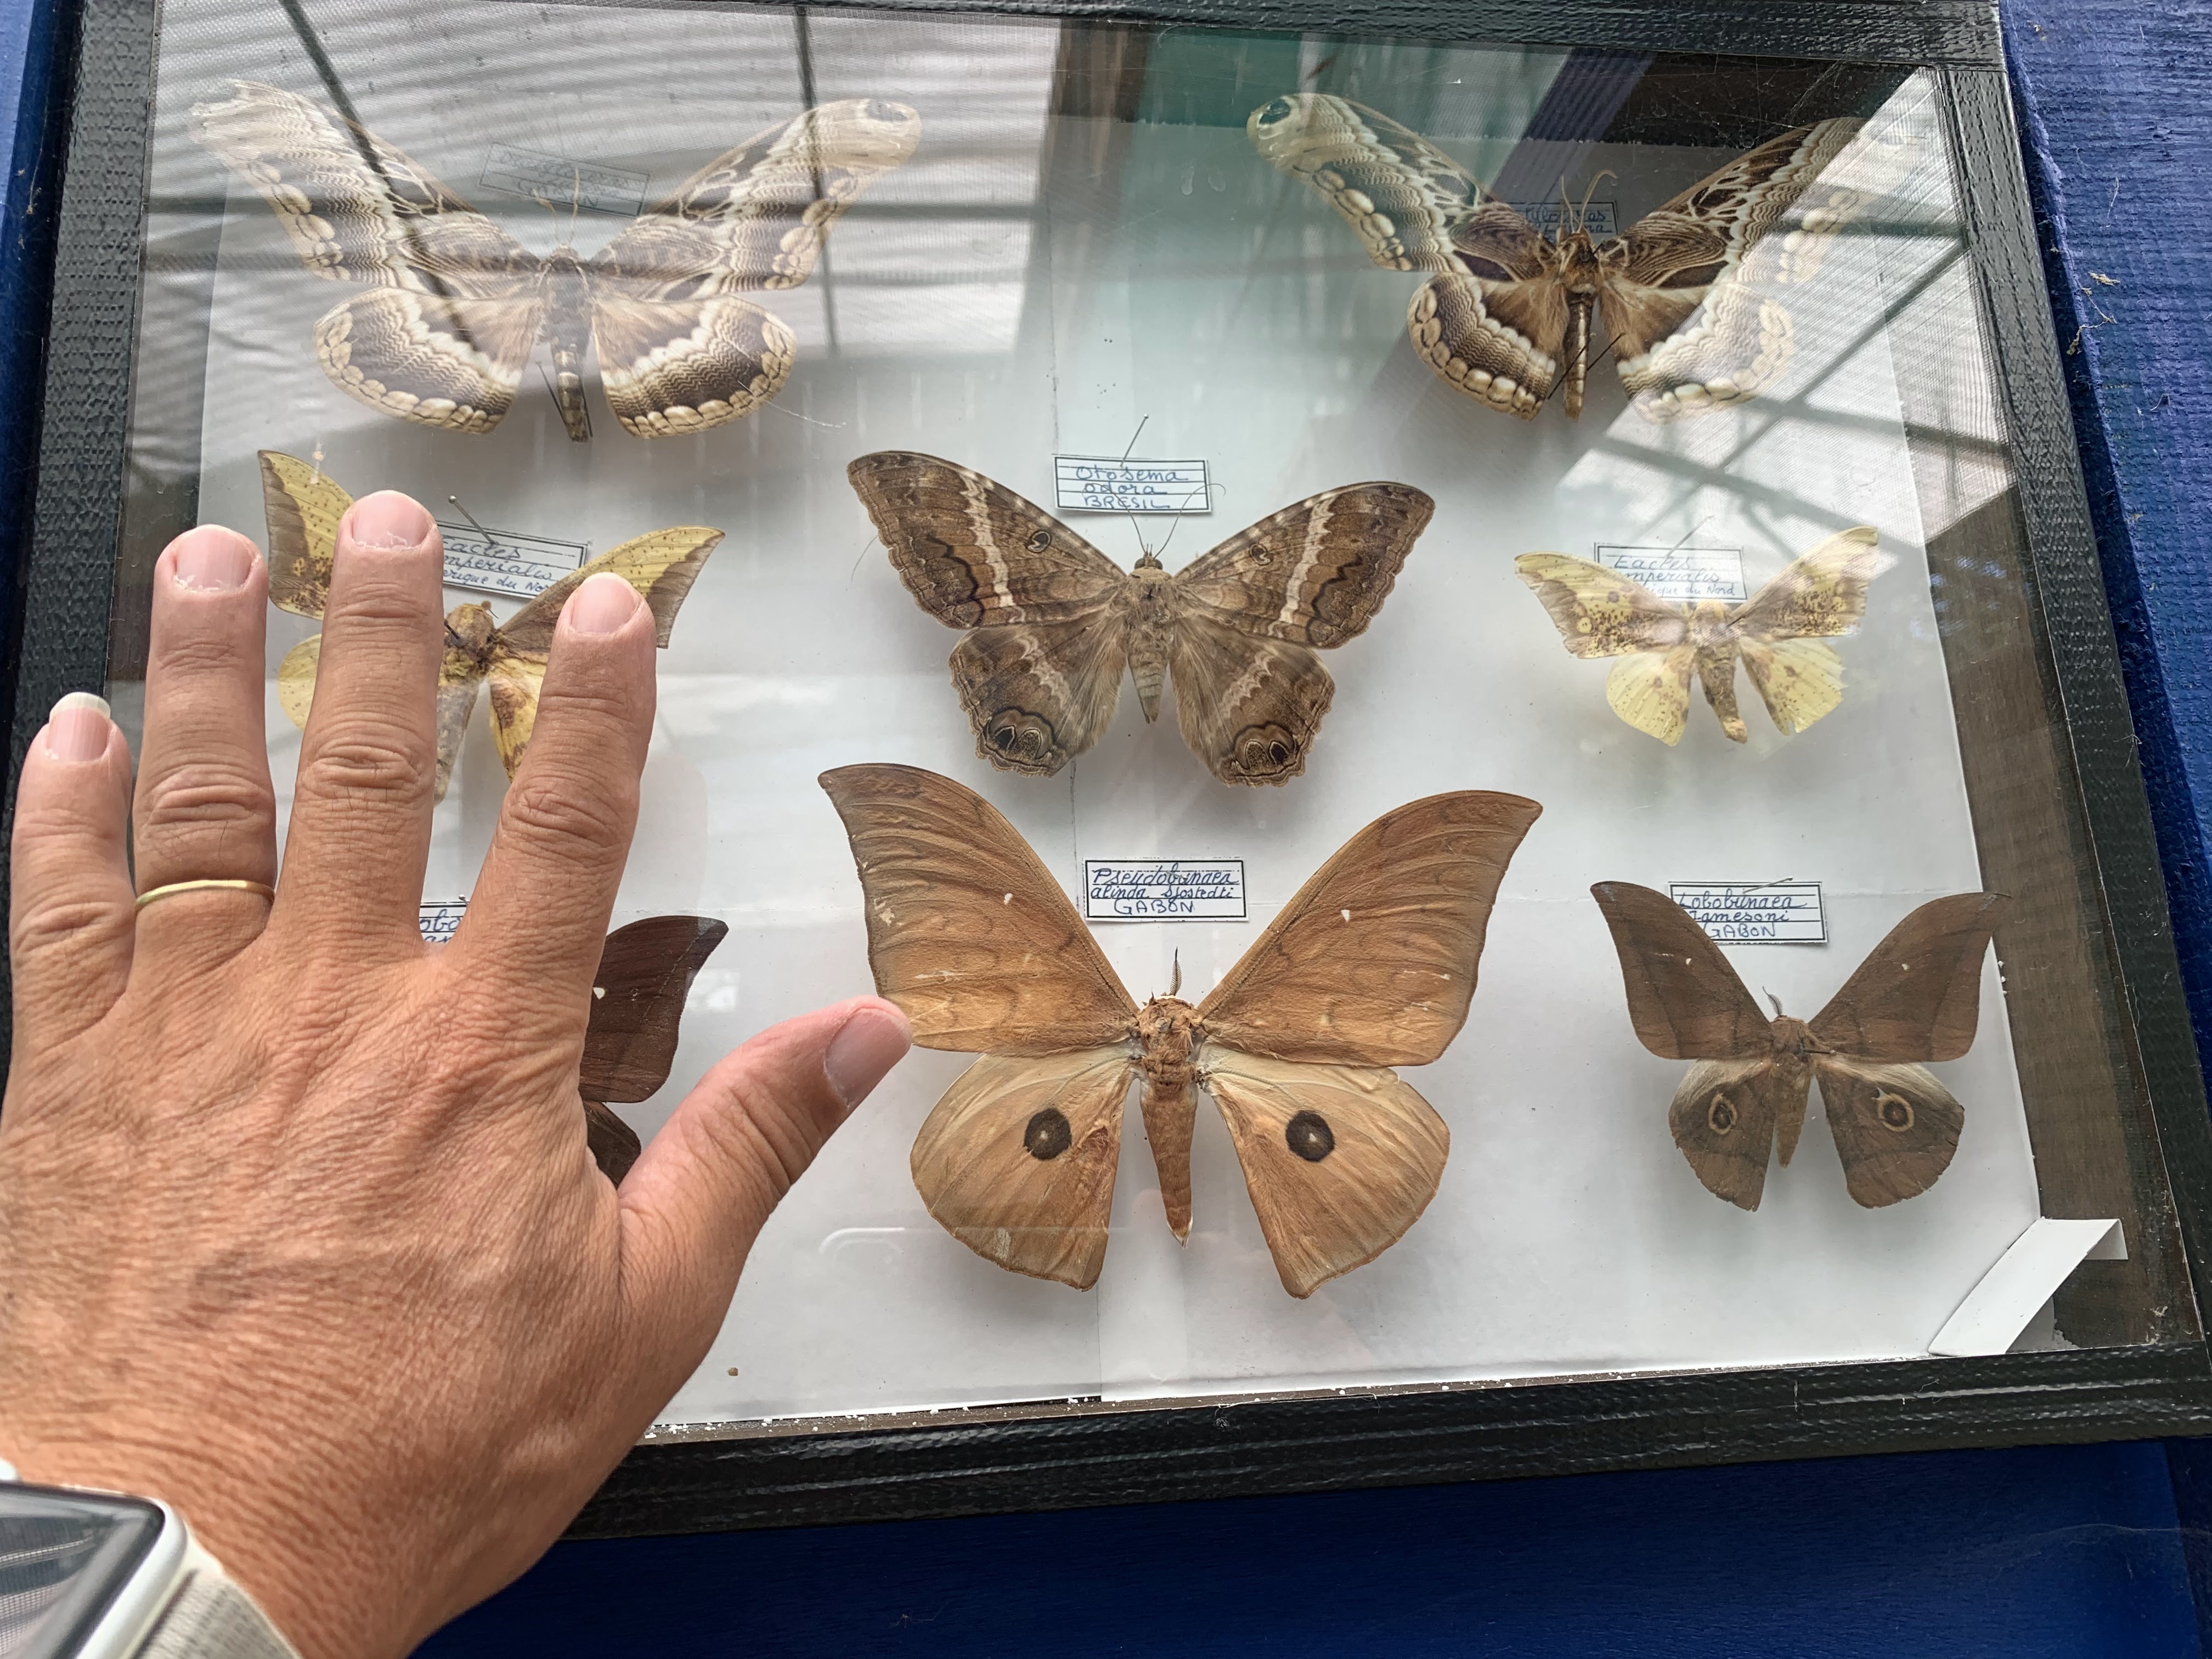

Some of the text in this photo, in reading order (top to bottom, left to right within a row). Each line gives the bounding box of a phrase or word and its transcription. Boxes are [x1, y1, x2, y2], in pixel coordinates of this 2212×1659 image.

[1076, 465, 1188, 481] Otosema
[1085, 481, 1168, 494] odora
[1085, 496, 1170, 509] BRESIL
[496, 575, 517, 589] du
[1685, 583, 1701, 595] du
[1707, 583, 1736, 596] Nord
[1092, 862, 1239, 885] Pseudobunaea
[1091, 884, 1149, 899] alinda
[1114, 899, 1194, 915] GABON
[1703, 922, 1775, 938] GABON
